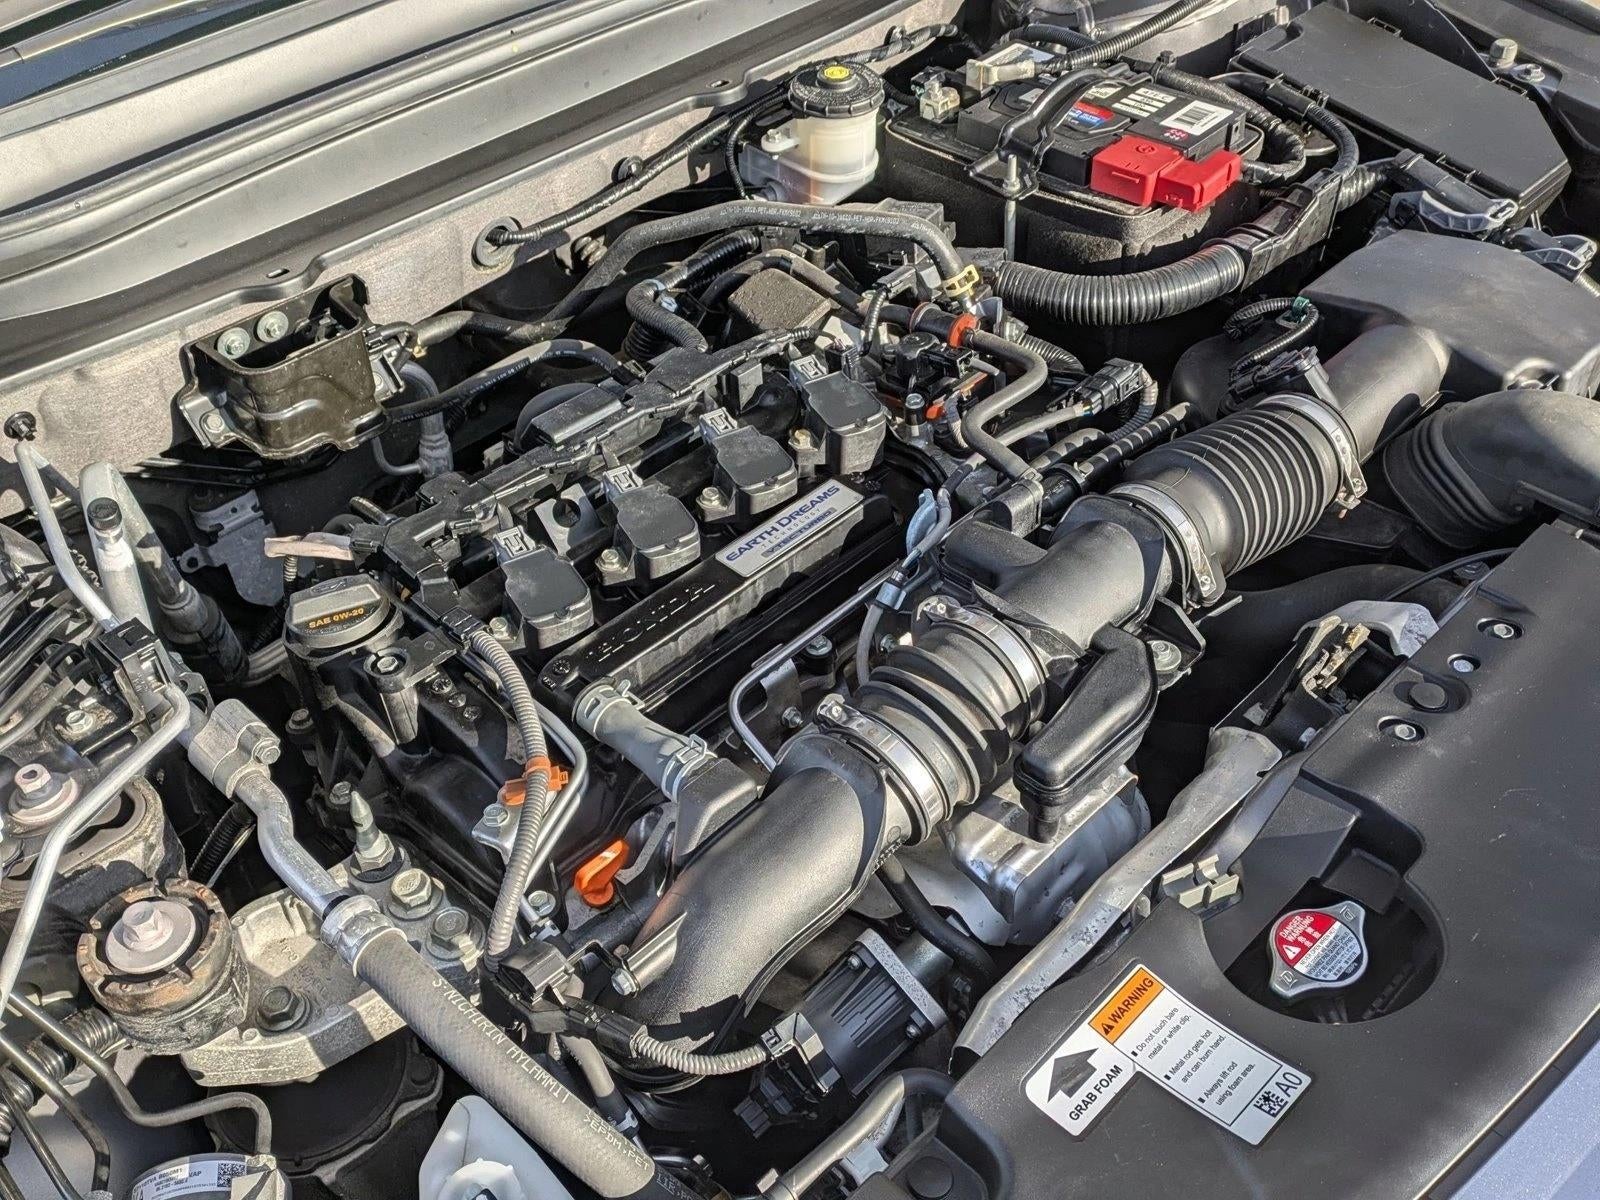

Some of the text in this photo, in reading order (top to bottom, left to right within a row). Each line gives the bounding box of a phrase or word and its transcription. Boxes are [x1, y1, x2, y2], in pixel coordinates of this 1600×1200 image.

[725, 485, 841, 562] EARTH DREAMS
[761, 507, 822, 550] TECHNOLOGY
[308, 614, 332, 629] SAE
[332, 607, 365, 622] 0W-20
[1279, 915, 1304, 937] DANGER
[1286, 915, 1315, 943] WARNUNG
[1108, 977, 1154, 1024] WARNING
[1136, 1007, 1179, 1052] Do not touch bare
[1148, 1014, 1192, 1060] metal or white clip.
[505, 1045, 573, 1104] HYLAMMIT
[1168, 1029, 1213, 1076] Metal rod gets hot
[1181, 1034, 1226, 1083] and can burn hand.
[1069, 1064, 1123, 1121] GRAB FOAM
[1203, 1061, 1238, 1099] Always lift rod
[1215, 1063, 1256, 1106] using foam area.
